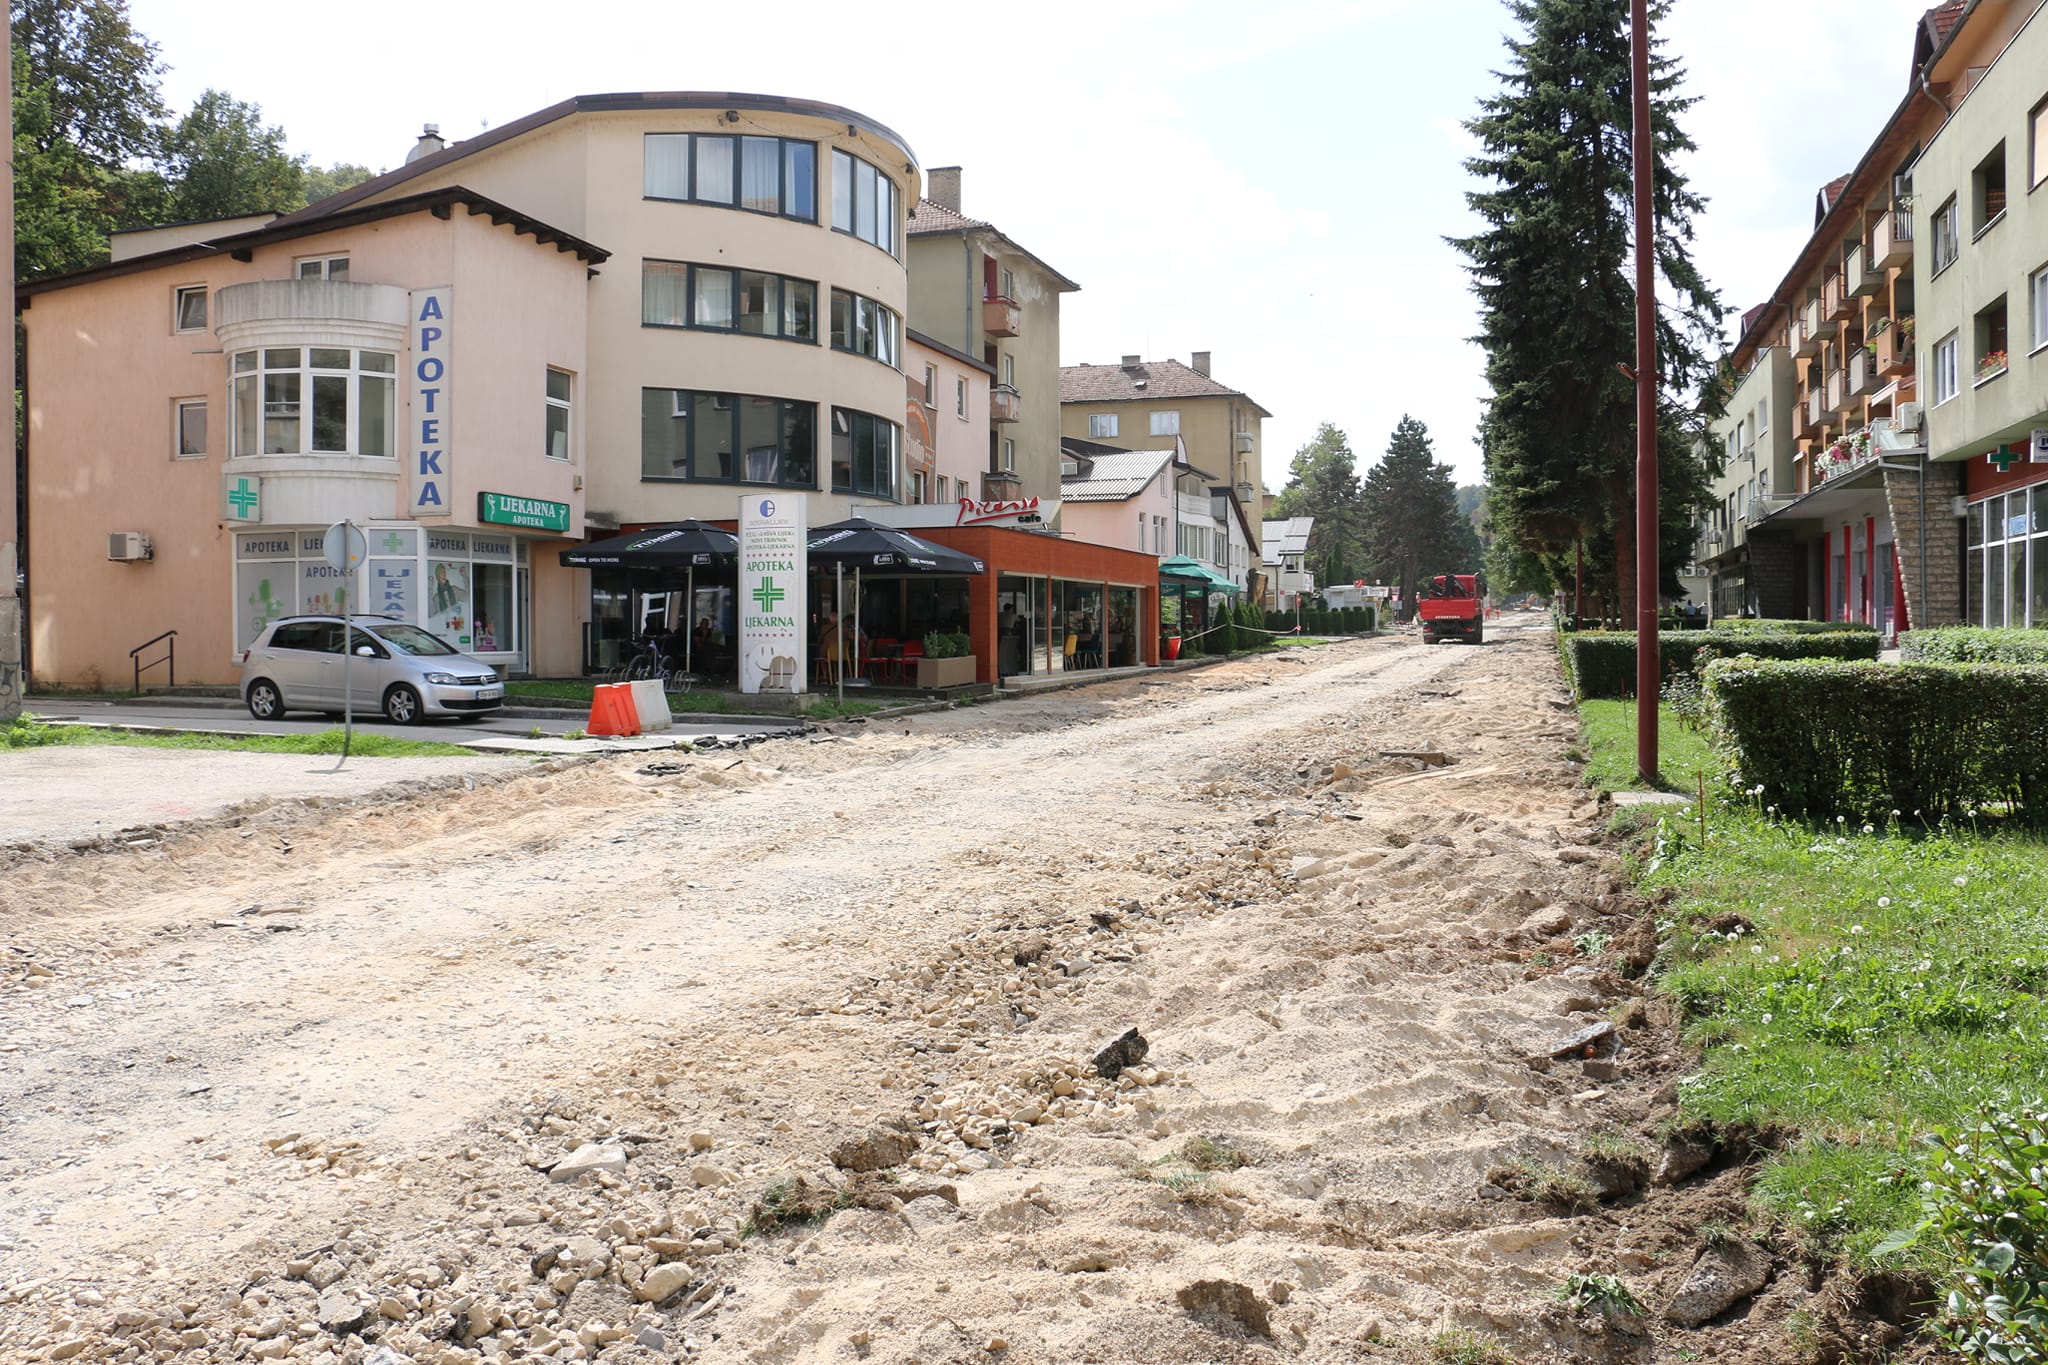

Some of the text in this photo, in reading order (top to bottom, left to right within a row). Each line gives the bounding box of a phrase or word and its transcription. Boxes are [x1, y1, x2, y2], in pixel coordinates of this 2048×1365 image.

[417, 296, 444, 506] APOTEKA
[500, 497, 556, 518] LJEKARNA
[512, 515, 544, 527] APOTEKA
[1018, 514, 1041, 523] cafe
[429, 538, 466, 551] APOTEKA
[633, 530, 686, 549] TUBORG
[807, 530, 858, 549] TUBORG
[245, 541, 289, 552] APOTEKA
[473, 541, 510, 554] LJEKARNA
[305, 566, 353, 578] APOTEK
[746, 560, 794, 572] APOTEKA
[745, 616, 794, 629] LJEKARNA
